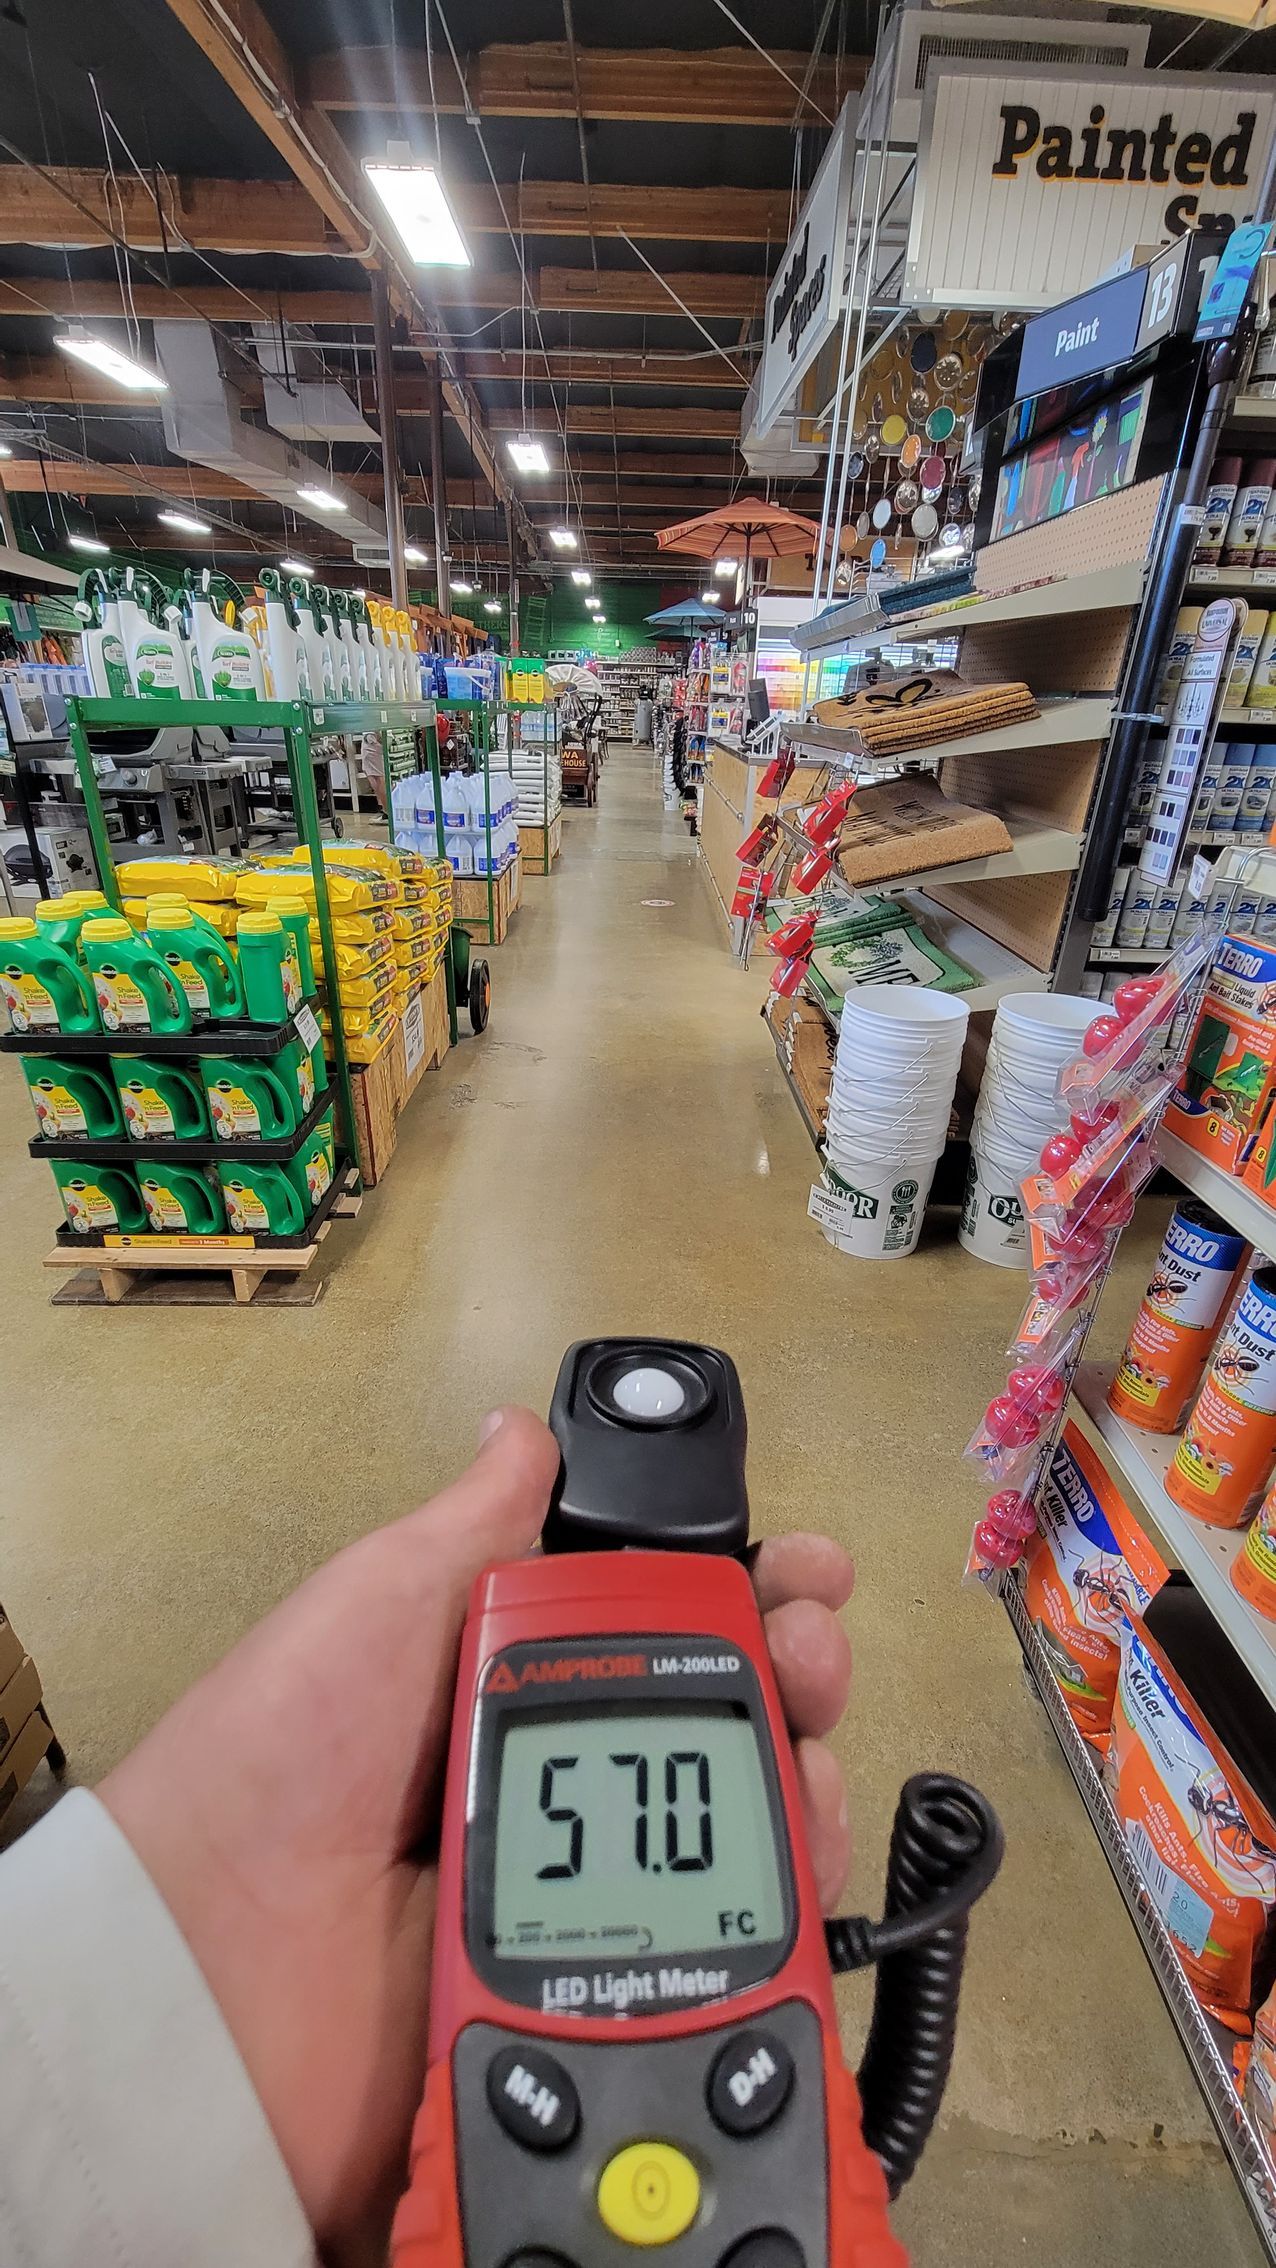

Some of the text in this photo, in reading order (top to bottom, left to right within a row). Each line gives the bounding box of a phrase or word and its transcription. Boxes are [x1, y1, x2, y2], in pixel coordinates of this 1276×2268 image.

[992, 105, 1256, 187] Painted
[1164, 195, 1242, 239] Sp
[1148, 263, 1177, 328] 13
[1198, 256, 1220, 313] 1
[1055, 317, 1099, 357] Paint
[744, 612, 756, 624] 10
[562, 751, 578, 759] WA
[1132, 899, 1152, 910] 2X
[1159, 899, 1177, 911] 2X
[1215, 902, 1226, 913] 2
[1239, 902, 1257, 913] 2X
[1265, 903, 1276, 914] 2
[1218, 942, 1262, 978] TERRO
[1208, 983, 1254, 1009] Ant Bait Stakes
[1234, 983, 1256, 999] Liquid
[1173, 1090, 1191, 1110] TERRO
[1209, 1121, 1217, 1133] 8
[1257, 1150, 1264, 1159] 8
[825, 1172, 874, 1218] DOOR
[991, 1197, 1022, 1218] OU
[1166, 1224, 1219, 1262] ERRO
[1158, 1251, 1201, 1282] nt Dust
[1239, 1293, 1276, 1338] ERR
[1230, 1323, 1275, 1361] nt Dust
[1052, 1448, 1095, 1523] TERRO
[1047, 1494, 1068, 1527] Killer
[1063, 1627, 1088, 1644] Fleas,
[1071, 1640, 1108, 1661] insects!
[520, 1655, 740, 1683] AMPROBE LM-200LED
[1142, 1716, 1158, 1739] Insect
[536, 1751, 714, 1880] 57.0
[1139, 1785, 1179, 1863] Cockroaches,
[1145, 1814, 1163, 1845] other
[1154, 1802, 1208, 1889] Kills Ants, Fire
[1172, 1891, 1188, 1911] 20
[717, 1909, 757, 1937] FC
[542, 1968, 729, 2009] LED Light Meter
[728, 2048, 777, 2107] D-H
[504, 2064, 560, 2127] M-H
